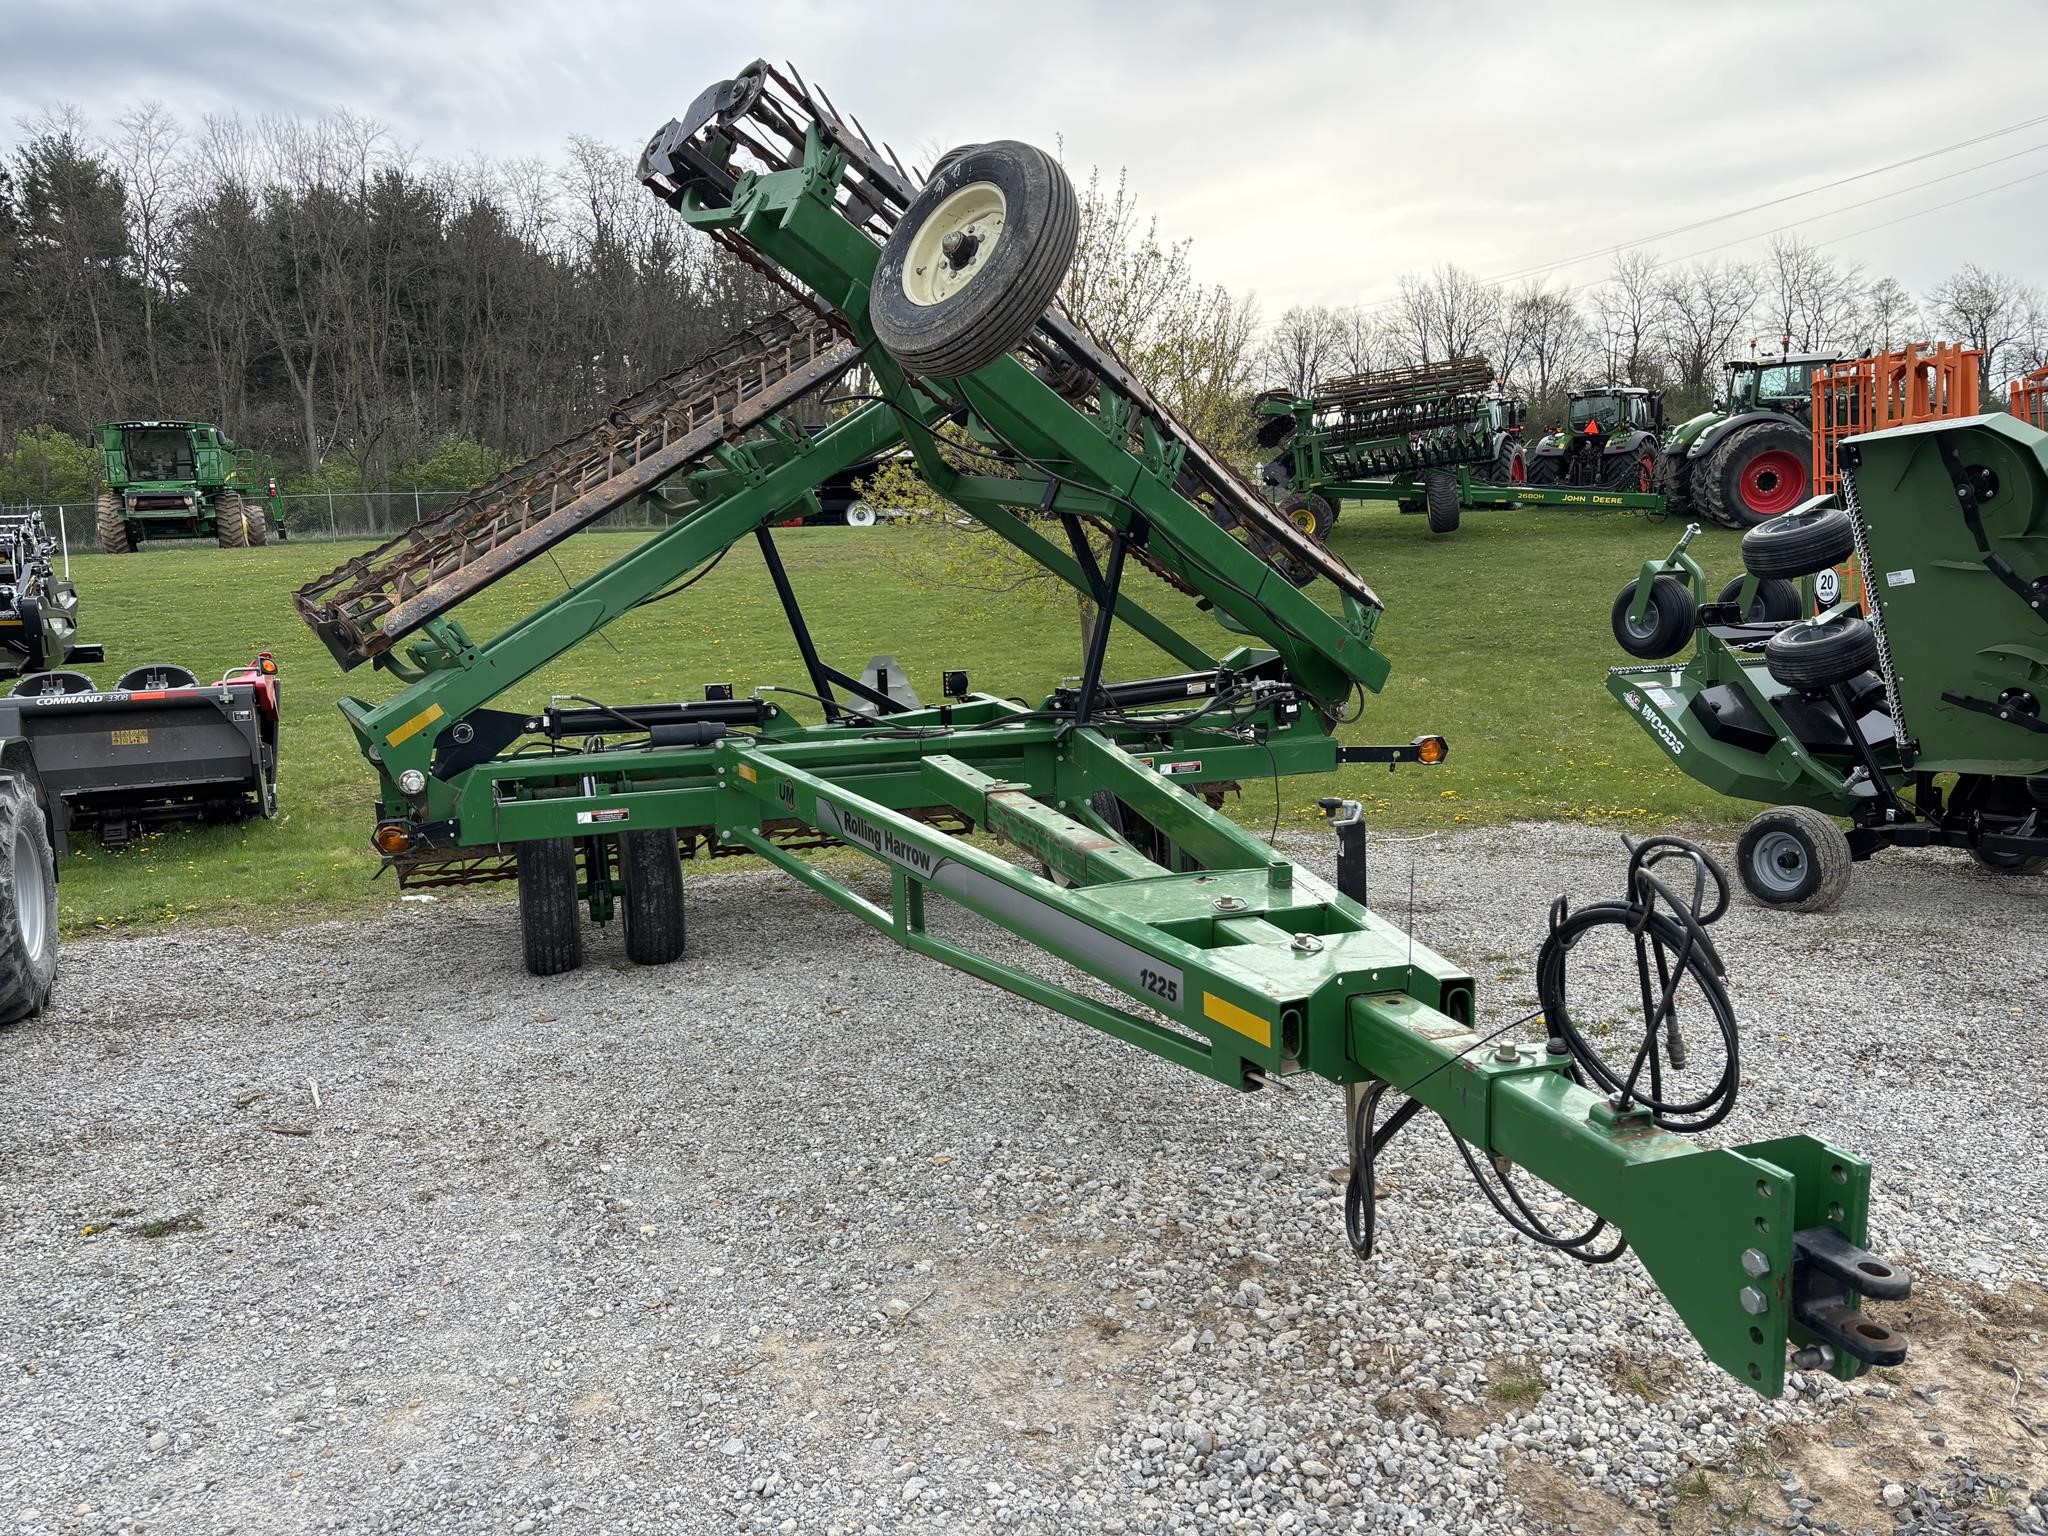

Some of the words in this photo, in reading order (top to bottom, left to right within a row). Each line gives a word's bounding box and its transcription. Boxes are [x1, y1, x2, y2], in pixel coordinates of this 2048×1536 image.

[1517, 492, 1545, 500] 2680H
[1562, 494, 1586, 502] JOHN
[1592, 495, 1623, 504] DEERE
[1820, 574, 1834, 590] 20
[36, 695, 103, 706] COMMAND
[108, 693, 129, 702] 3308
[1641, 703, 1685, 755] WOODS
[778, 782, 795, 803] UM
[844, 811, 882, 851] Rolling
[884, 829, 931, 871] Harrow
[1140, 968, 1178, 1002] 1225
